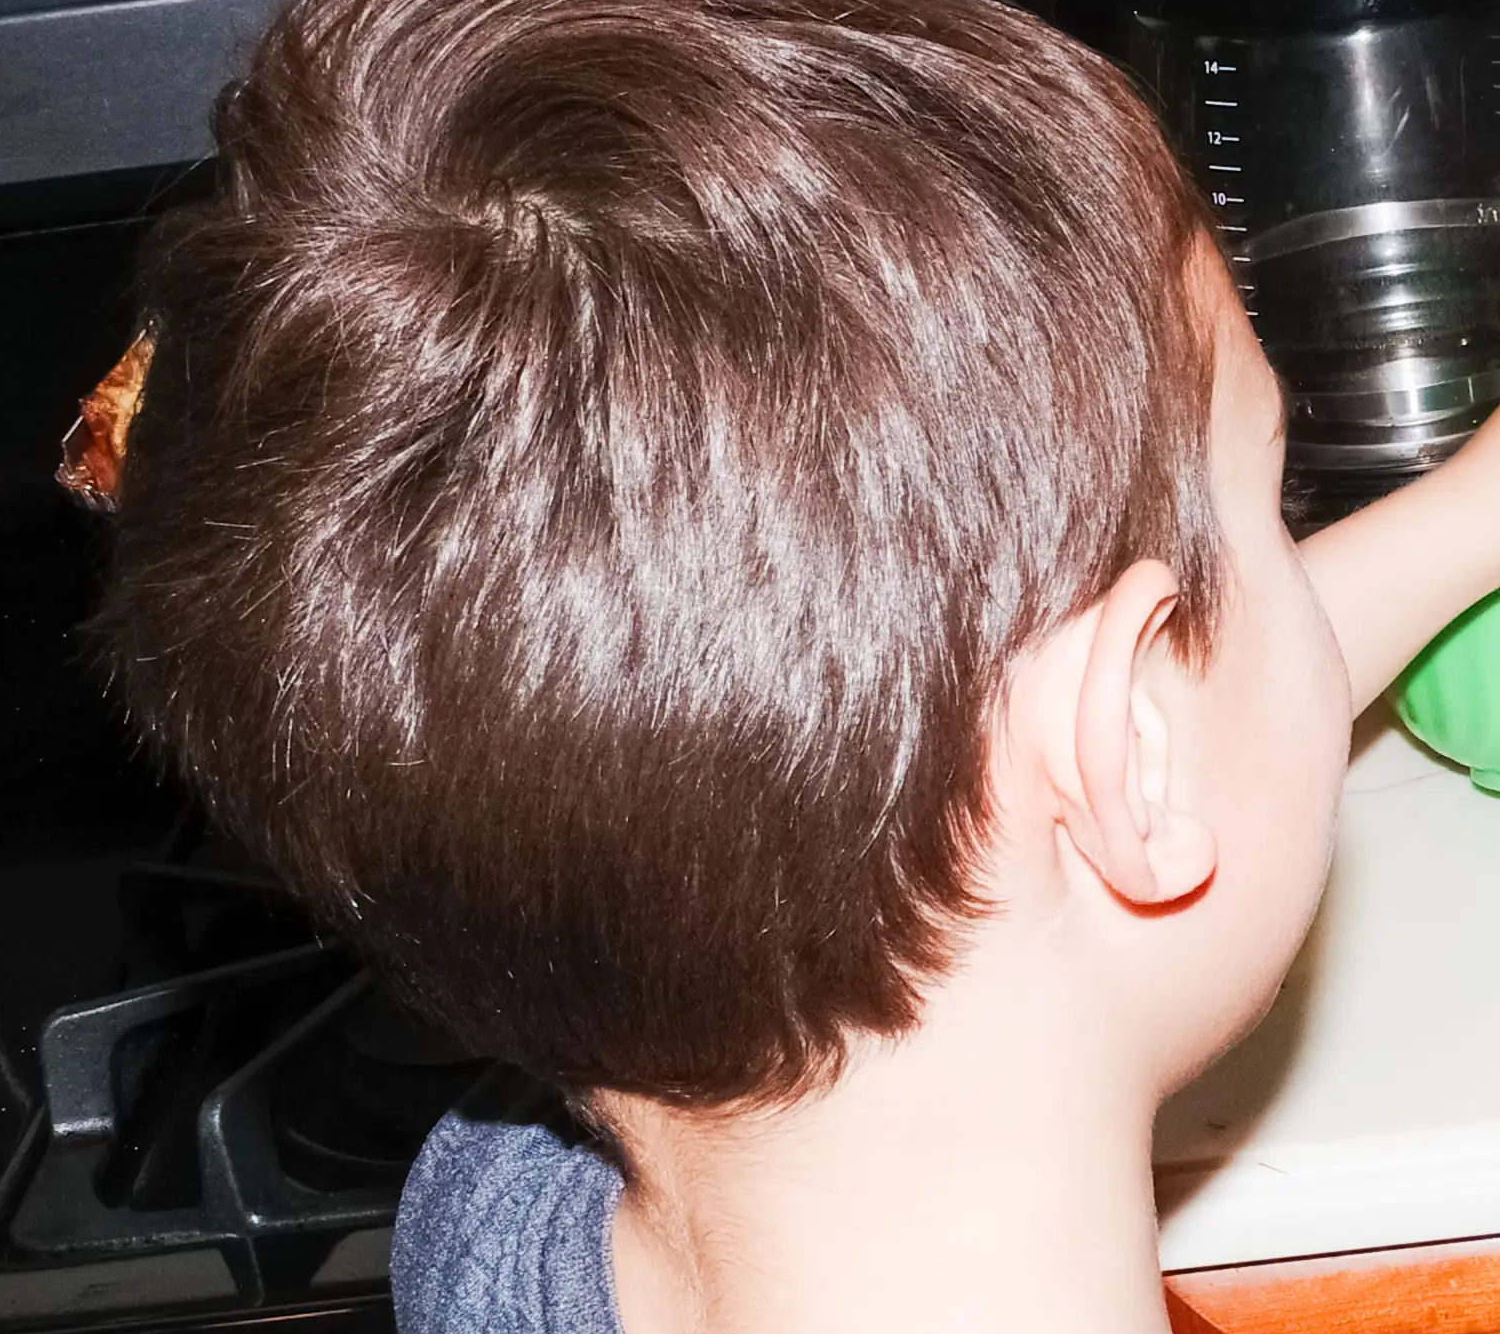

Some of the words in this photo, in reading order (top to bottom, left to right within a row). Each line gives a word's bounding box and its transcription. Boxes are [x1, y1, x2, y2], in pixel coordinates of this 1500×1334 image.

[1204, 60, 1219, 74] 14
[1207, 131, 1222, 145] 12
[1212, 192, 1227, 205] 10
